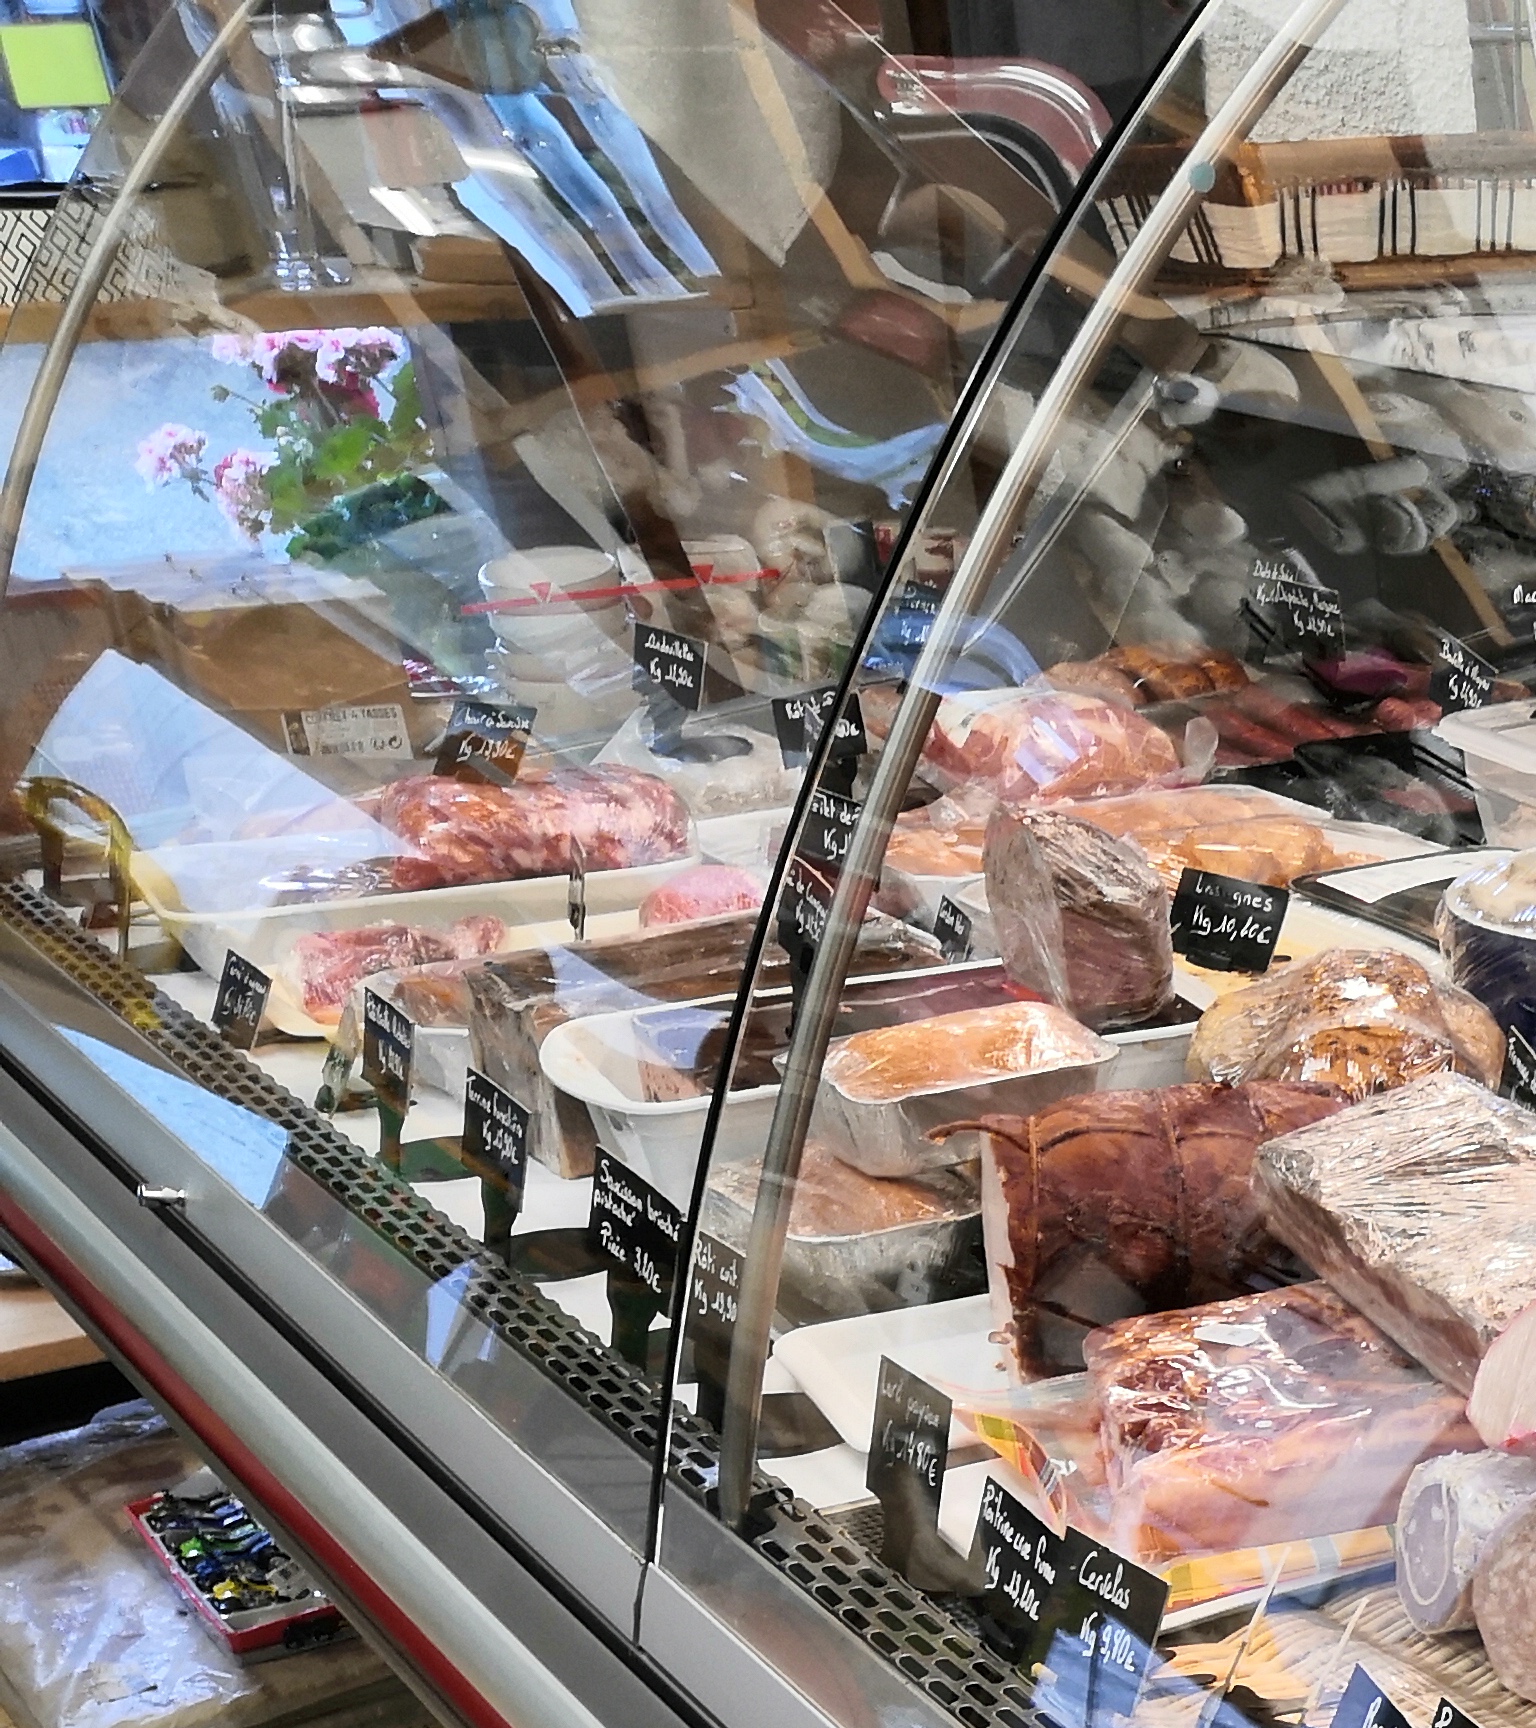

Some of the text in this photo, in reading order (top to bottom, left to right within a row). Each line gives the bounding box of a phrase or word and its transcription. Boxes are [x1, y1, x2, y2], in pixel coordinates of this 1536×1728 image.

[1190, 903, 1212, 936] Kg
[983, 1543, 1001, 1590] Kg
[1079, 1609, 1099, 1658] Kg
